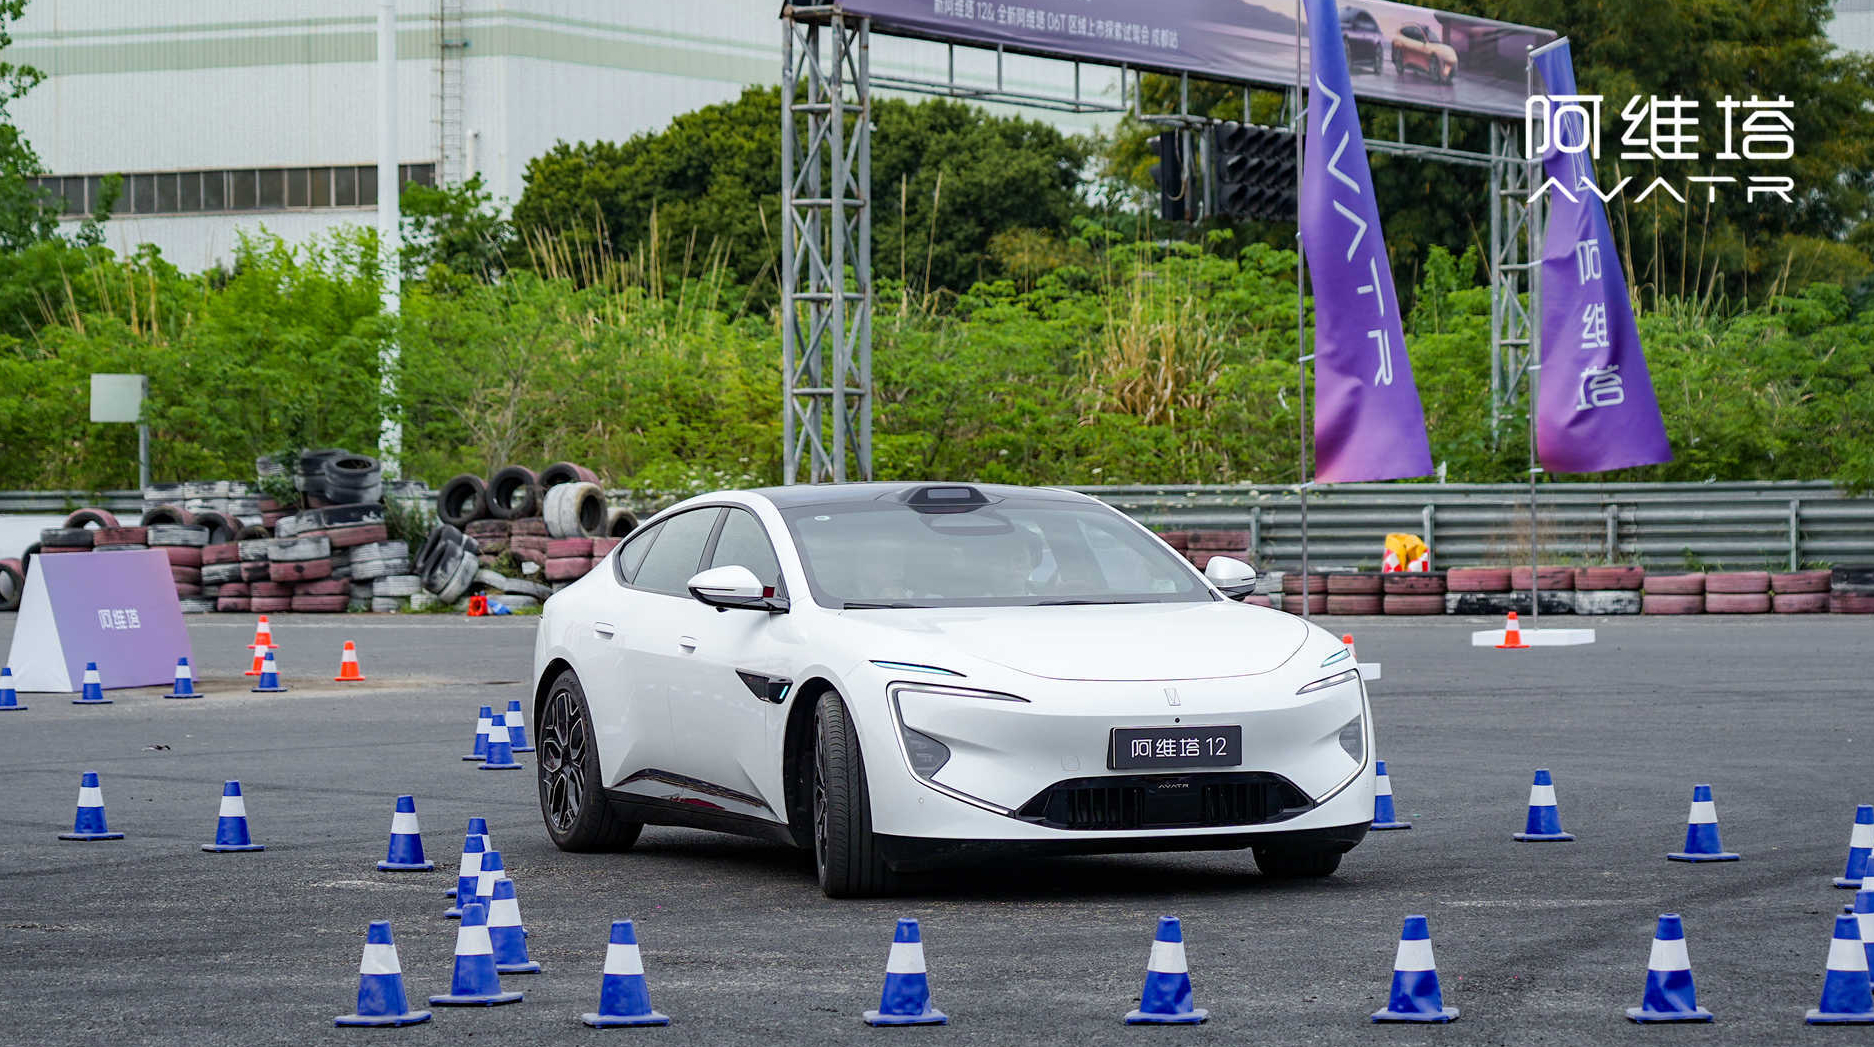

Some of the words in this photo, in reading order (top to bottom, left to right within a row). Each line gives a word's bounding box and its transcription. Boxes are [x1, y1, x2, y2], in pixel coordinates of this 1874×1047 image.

[997, 4, 1046, 31] 全新阿维塔
[1315, 72, 1394, 387] AVATR
[1576, 238, 1625, 412] 阿维塔
[97, 607, 141, 630] 阿维塔
[1131, 738, 1200, 758] 阿维塔
[1205, 737, 1228, 756] 12
